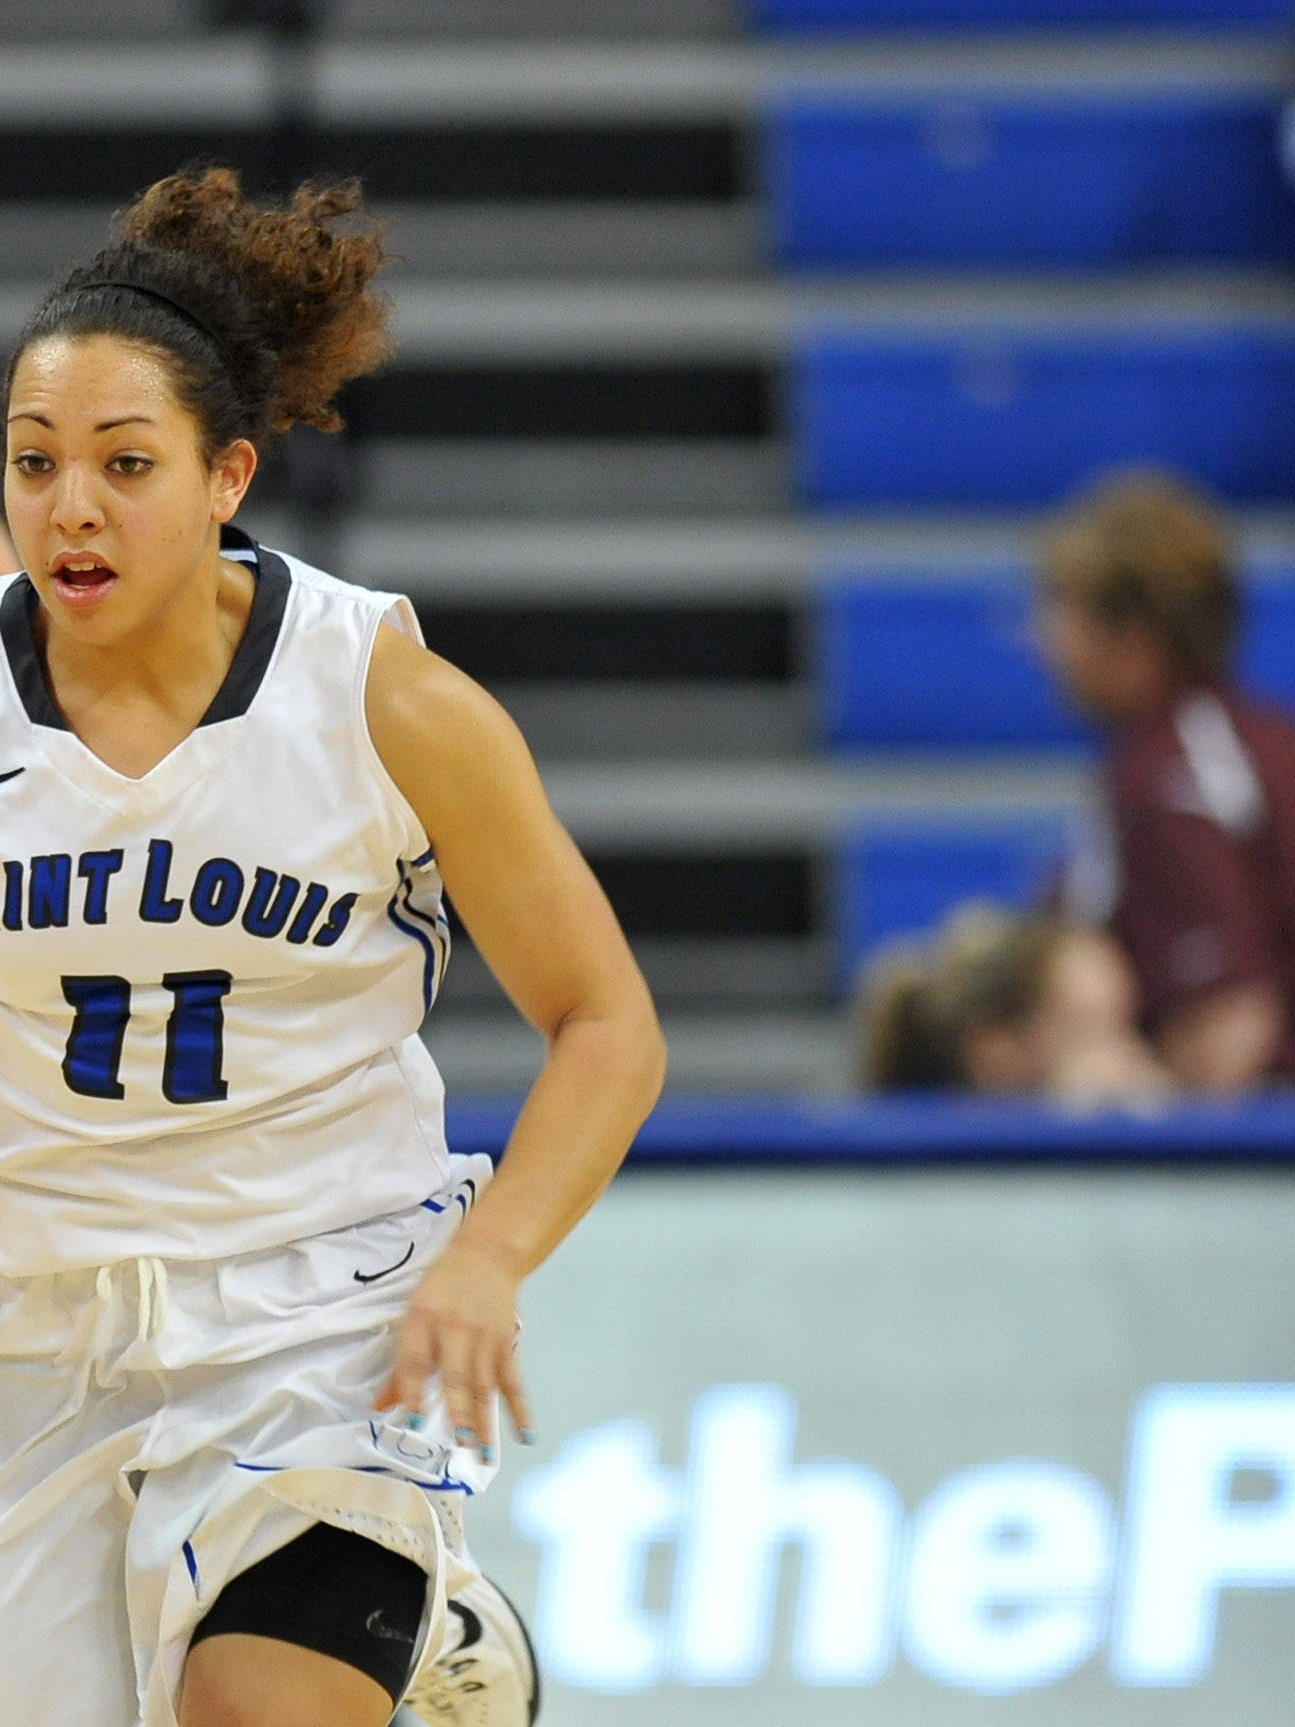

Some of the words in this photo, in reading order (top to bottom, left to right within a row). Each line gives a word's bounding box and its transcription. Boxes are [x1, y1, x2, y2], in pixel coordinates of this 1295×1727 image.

[138, 838, 361, 948] LOUIS
[60, 968, 234, 1104] 11
[510, 1382, 1295, 1696] theP
